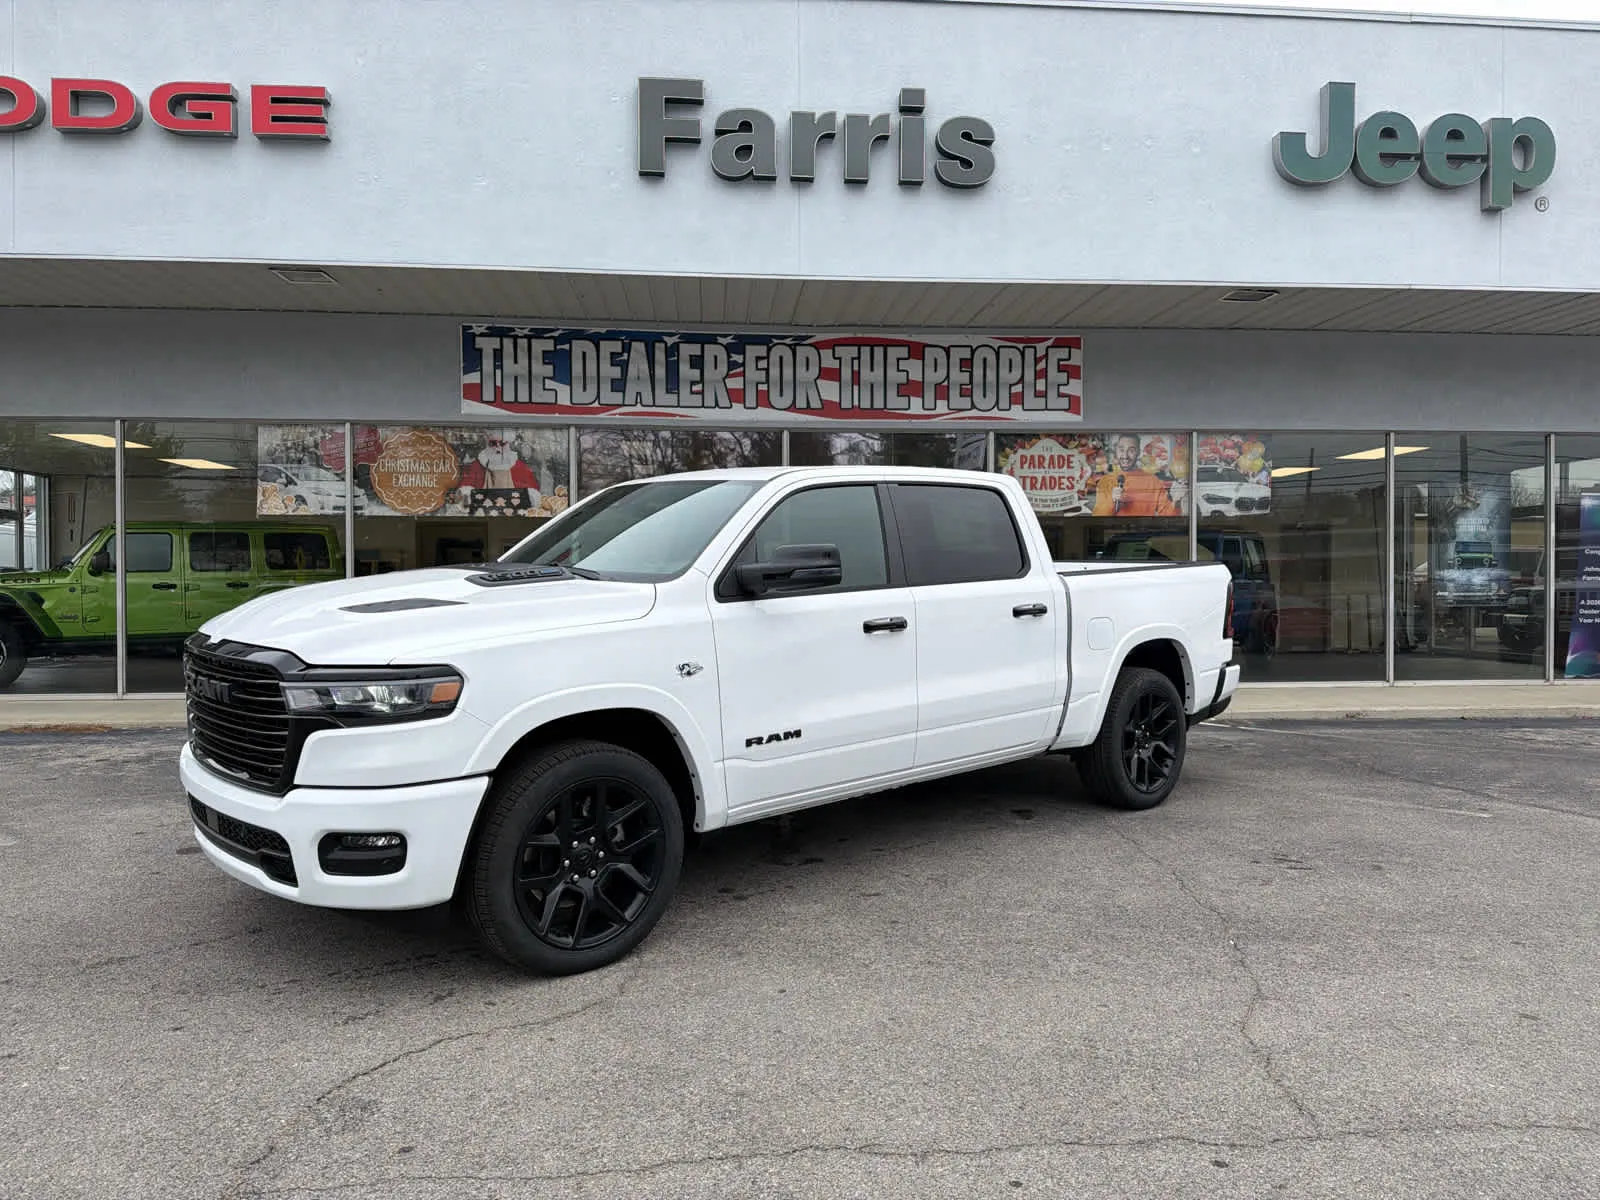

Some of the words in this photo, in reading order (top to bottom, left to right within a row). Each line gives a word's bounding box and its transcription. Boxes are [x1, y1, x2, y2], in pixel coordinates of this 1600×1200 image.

[638, 76, 996, 189] Farris
[1272, 81, 1556, 213] Jeep
[474, 336, 558, 405] THE
[569, 338, 733, 409] DEALER
[743, 343, 823, 411] FOR
[833, 344, 911, 411] THE
[922, 344, 1071, 412] PEOPLE
[379, 459, 430, 472] CHRISTMAS
[433, 459, 451, 473] CAR
[1020, 454, 1075, 470] PARADE
[393, 474, 438, 487] EXCHANGE
[1019, 476, 1075, 491] TRADES
[745, 729, 802, 748] RAM
